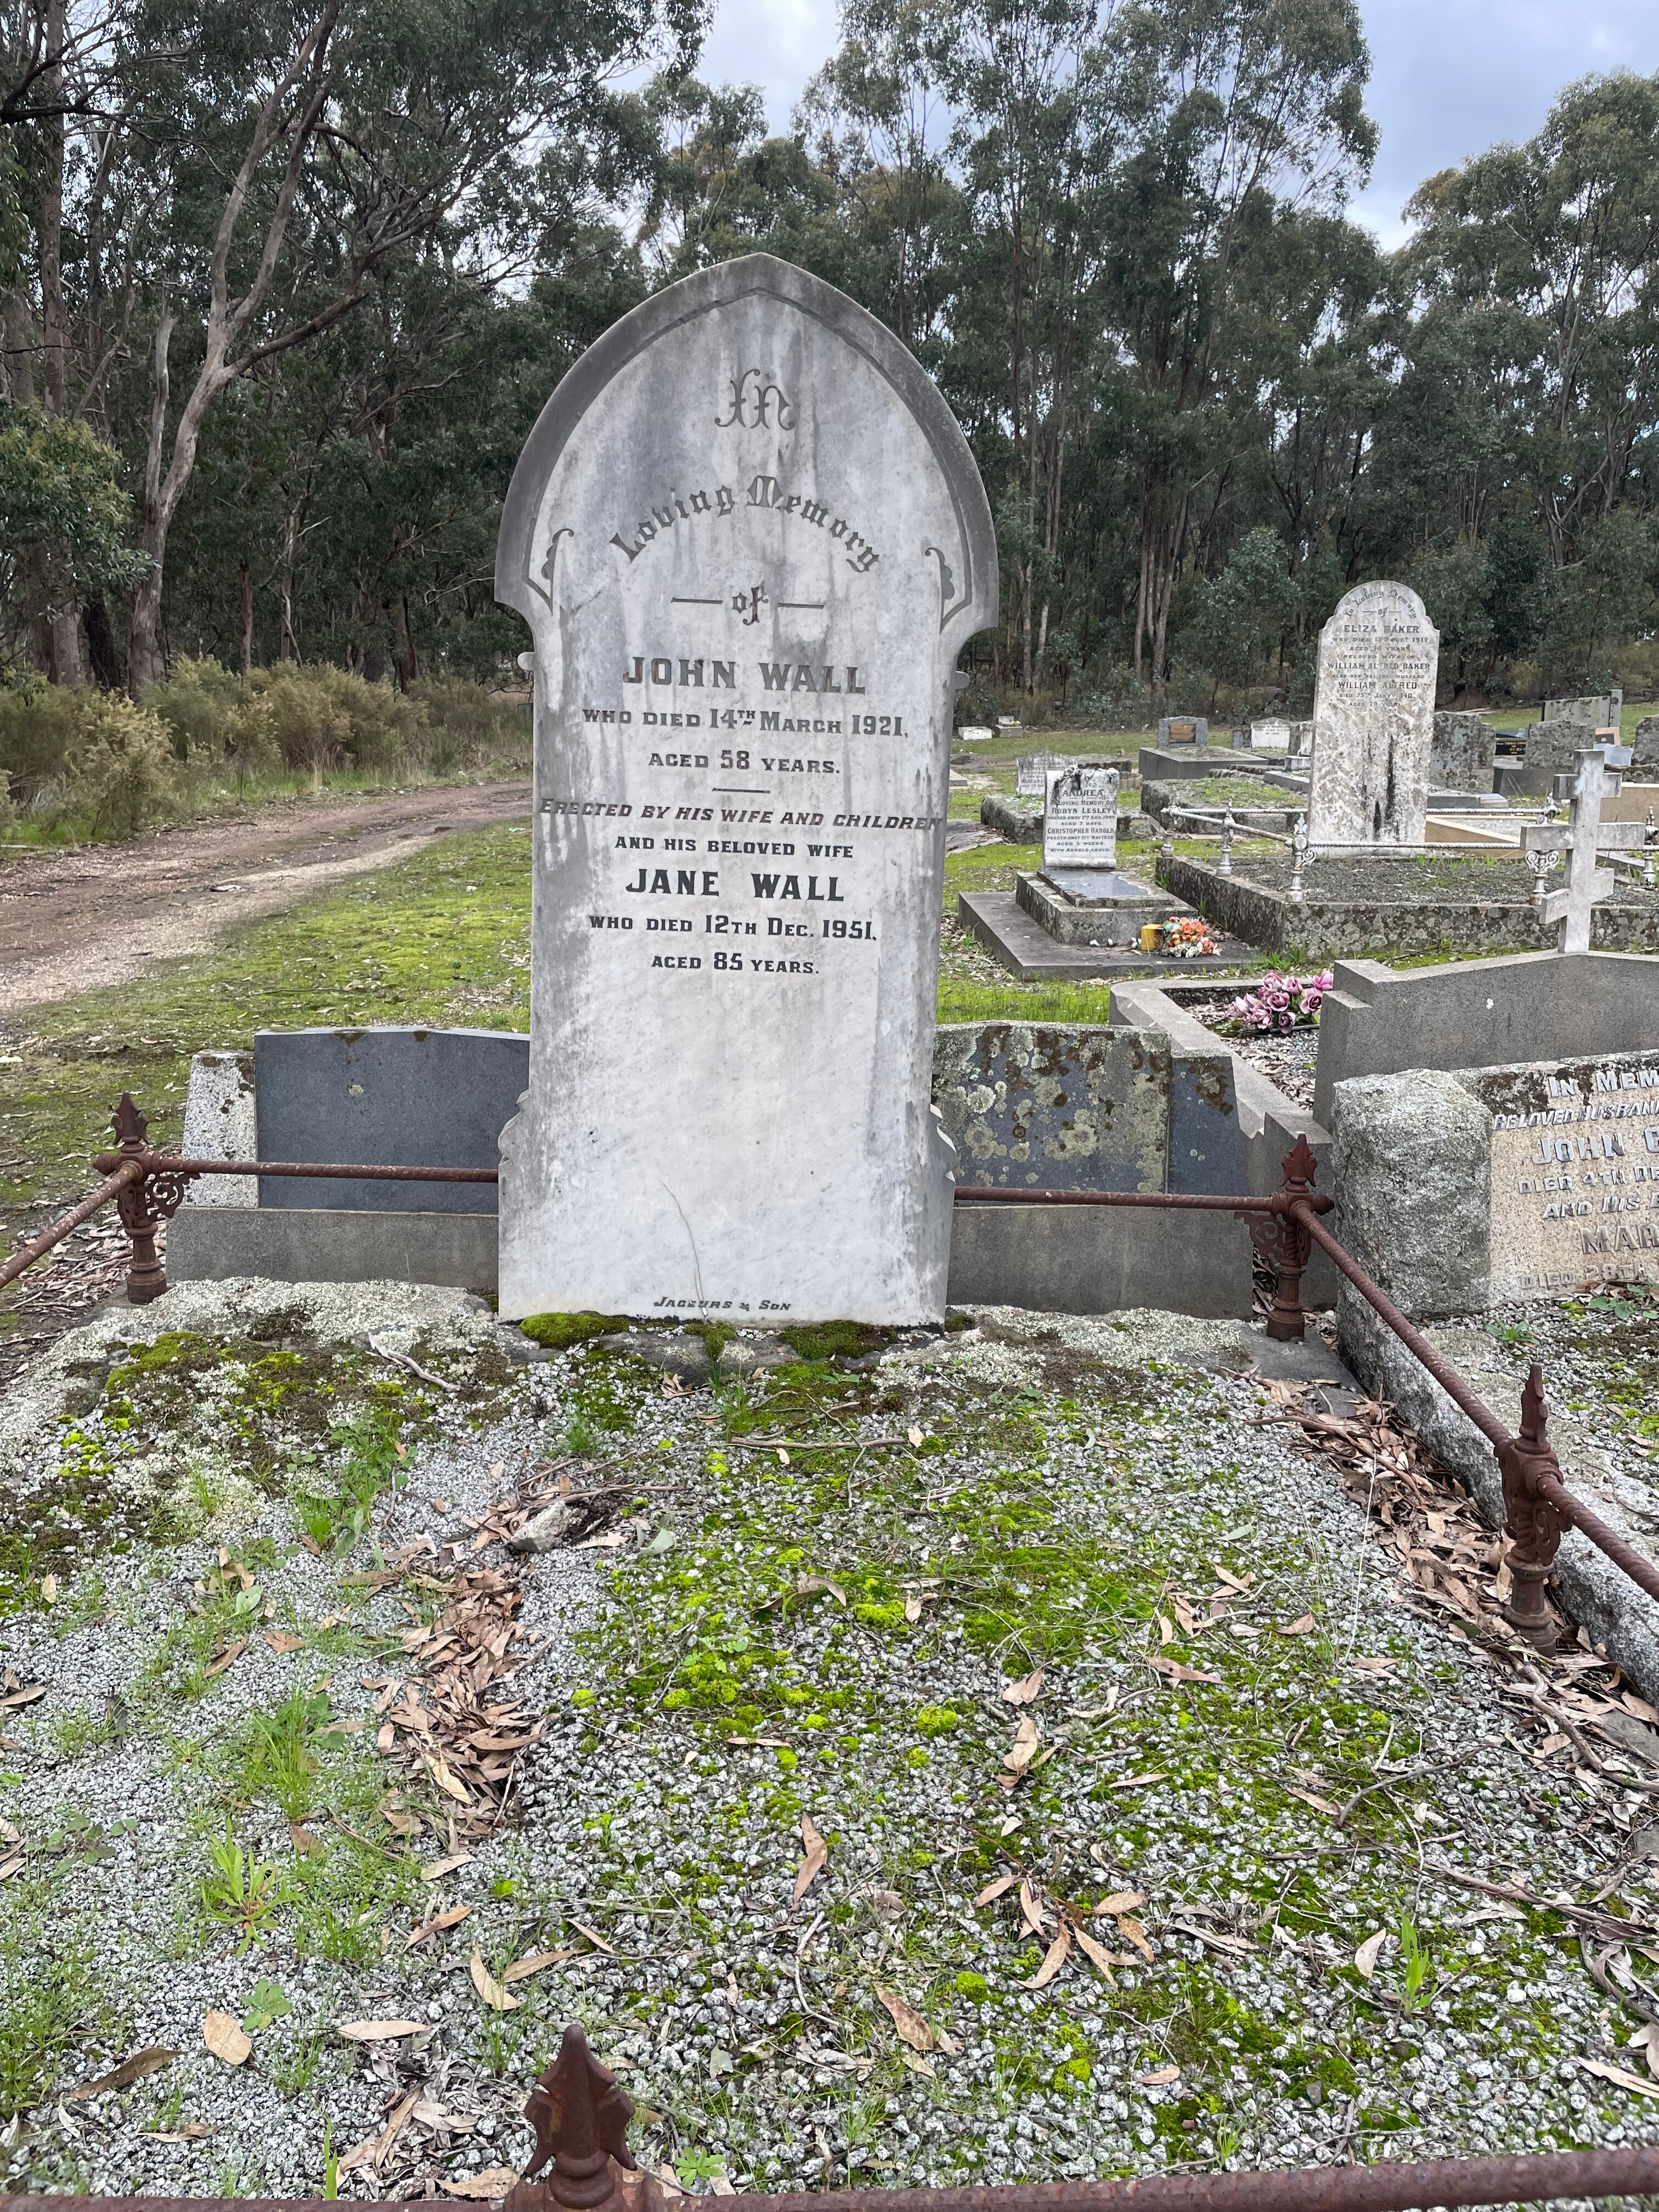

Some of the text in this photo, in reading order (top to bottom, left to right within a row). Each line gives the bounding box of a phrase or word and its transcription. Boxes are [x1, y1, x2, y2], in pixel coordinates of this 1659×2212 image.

[610, 475, 879, 573] Loving Memory
[732, 586, 769, 626] of
[1352, 591, 1384, 606] Loving
[1389, 589, 1417, 619] Memory
[1378, 607, 1387, 618] of
[1384, 625, 1419, 633] BAKER
[623, 657, 865, 695] JOHN WALL
[582, 709, 631, 724] WHO
[643, 712, 700, 727] DIED
[709, 709, 755, 729] 14TH
[648, 749, 839, 774] AGED 58 YEARS.
[538, 799, 943, 830] ERECTED BY HIS WIFE AND CHILDREN
[615, 836, 853, 858] AND HIS BELOVED WIFE
[625, 868, 844, 901] JANE WALL
[590, 916, 633, 929] WHO
[646, 918, 692, 932] DIED
[705, 915, 757, 934] 12TH
[651, 952, 819, 974] AGED 85 YEARS.
[1548, 1076, 1577, 1097] IN
[1493, 1099, 1659, 1131] BELOVED HUSBAN
[1532, 1133, 1625, 1164] JOHN
[1518, 1176, 1572, 1194] DIED
[1583, 1170, 1626, 1186] 4TH
[1542, 1200, 1593, 1219] AND
[1602, 1196, 1640, 1214] HIS
[1518, 1270, 1576, 1289] DIED
[739, 1302, 750, 1312] &
